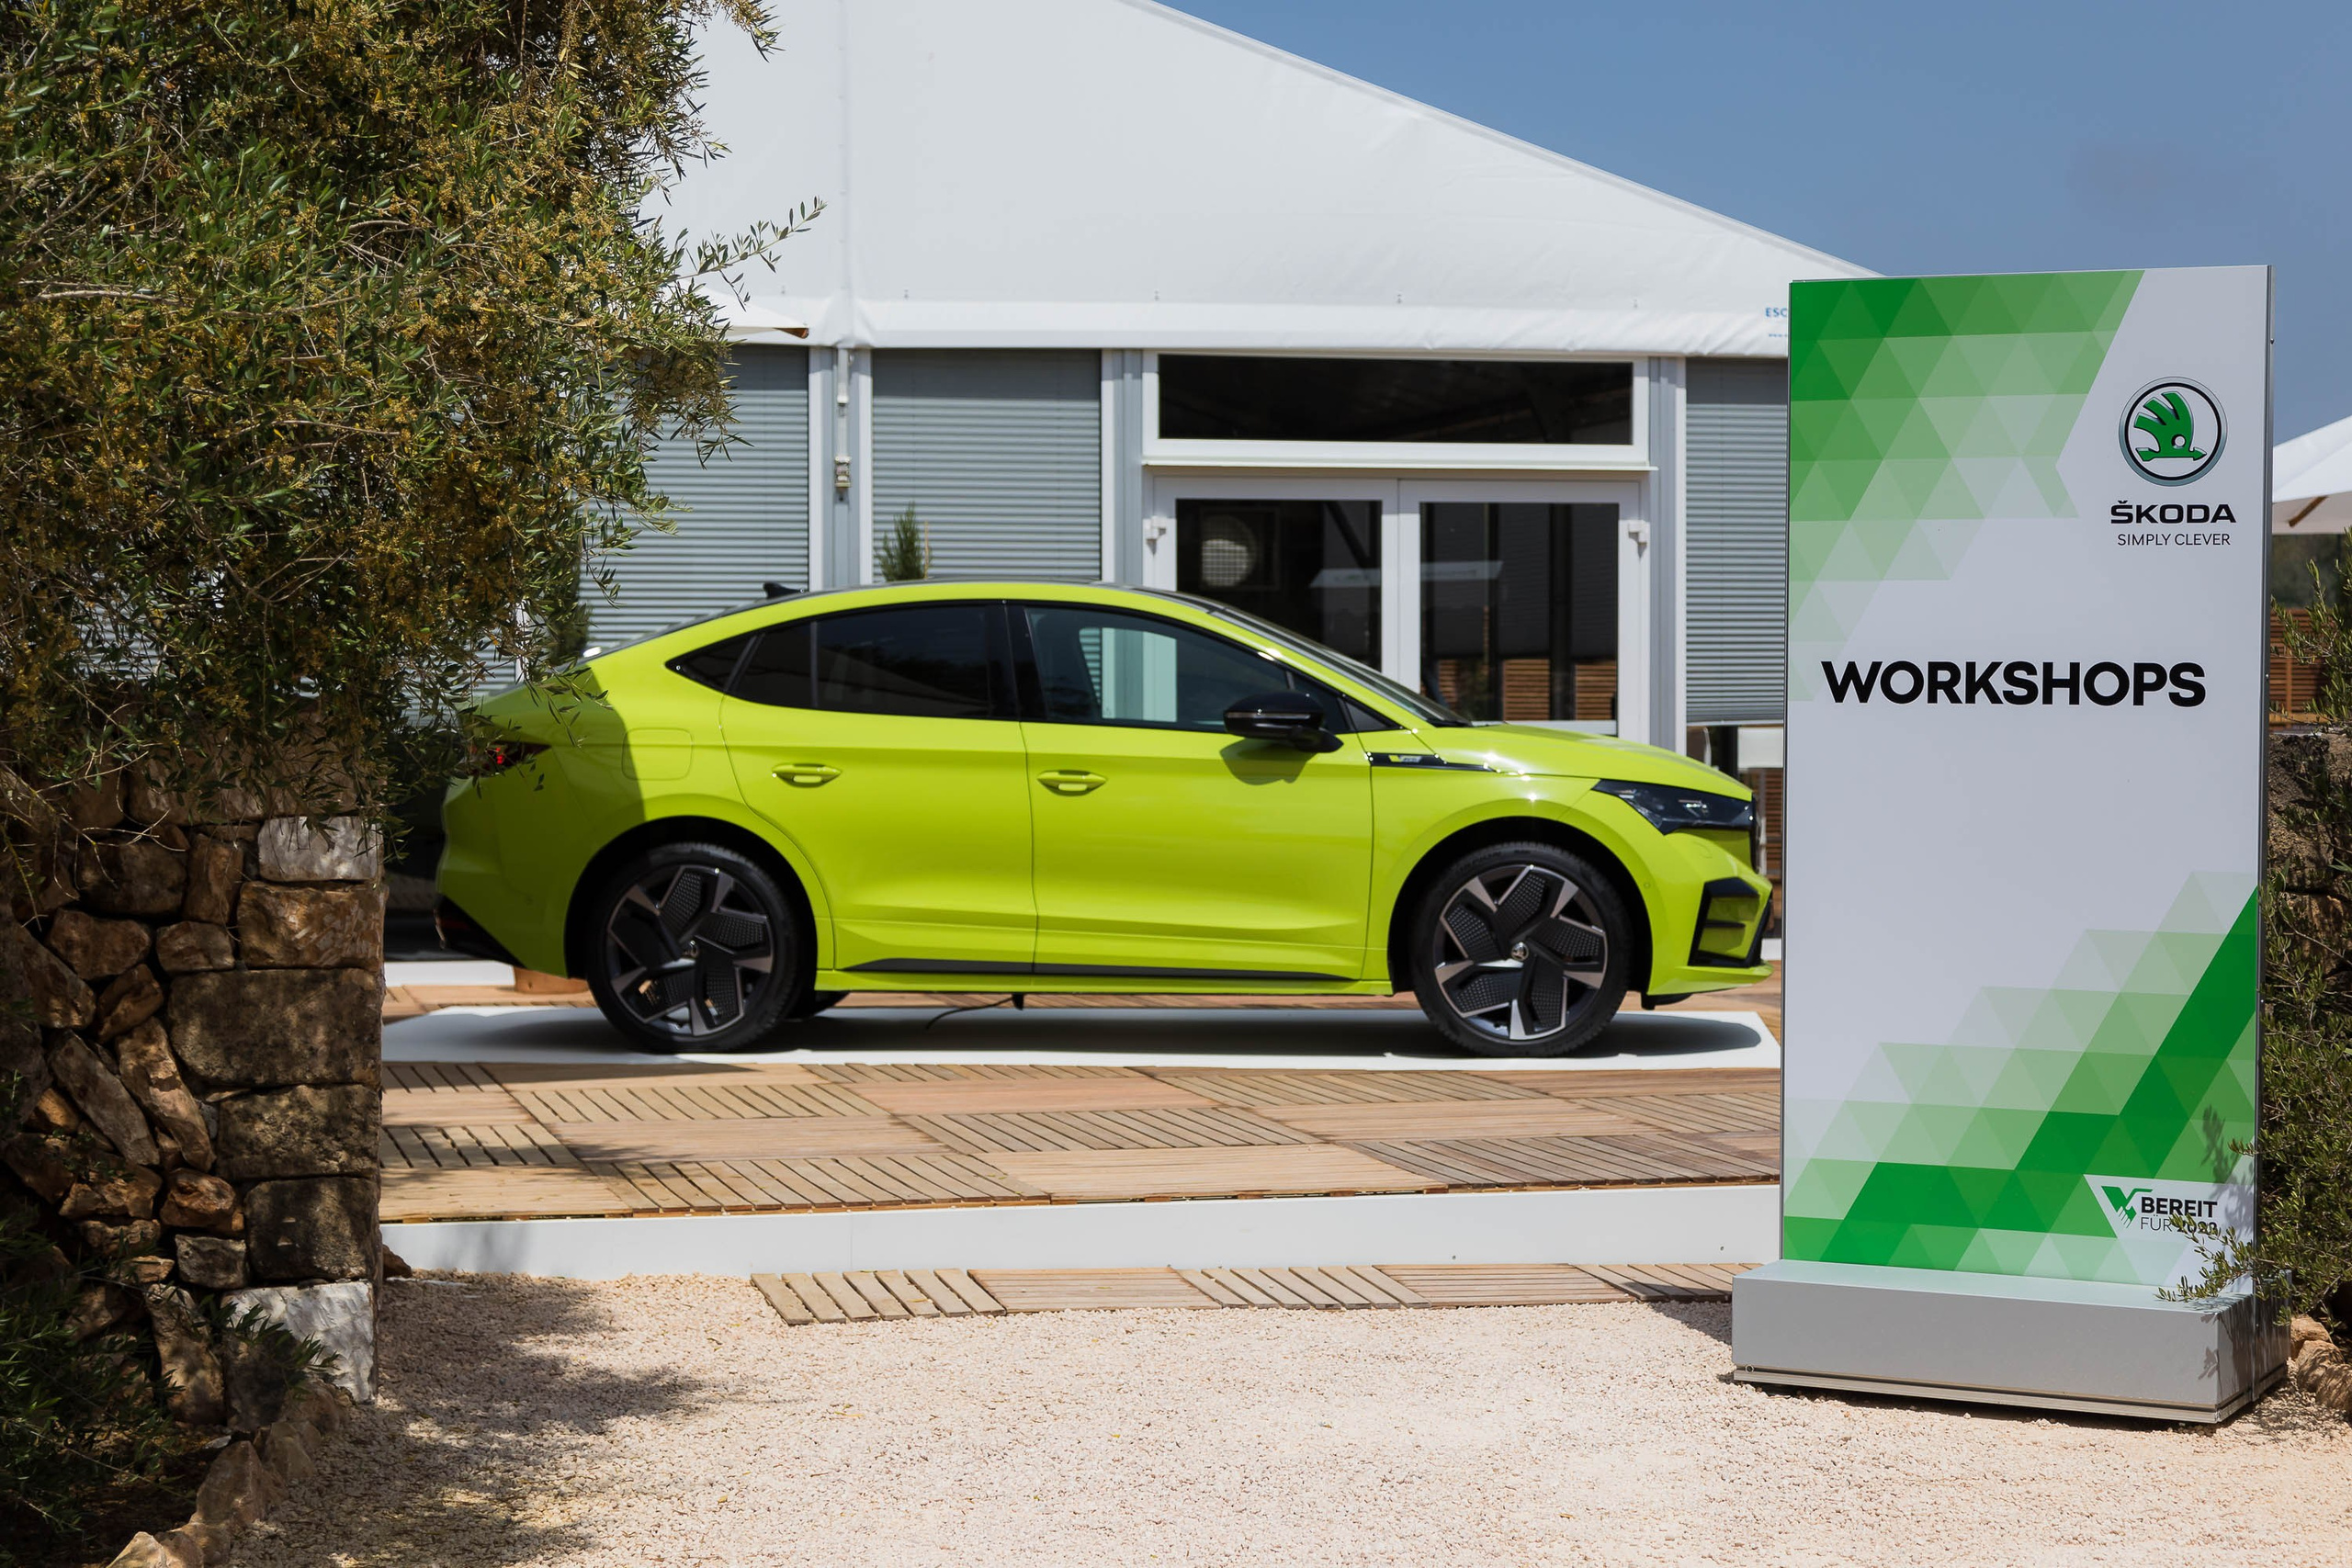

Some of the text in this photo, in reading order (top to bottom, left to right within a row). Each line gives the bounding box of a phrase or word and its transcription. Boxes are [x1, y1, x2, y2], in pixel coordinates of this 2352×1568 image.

[2110, 500, 2236, 524] ŠKODA
[2118, 534, 2231, 546] SIMPLY CLEVER
[1821, 660, 2206, 707] WORKSHOPS
[2141, 1196, 2218, 1218] BEREIT
[2141, 1214, 2173, 1232] FÜR
